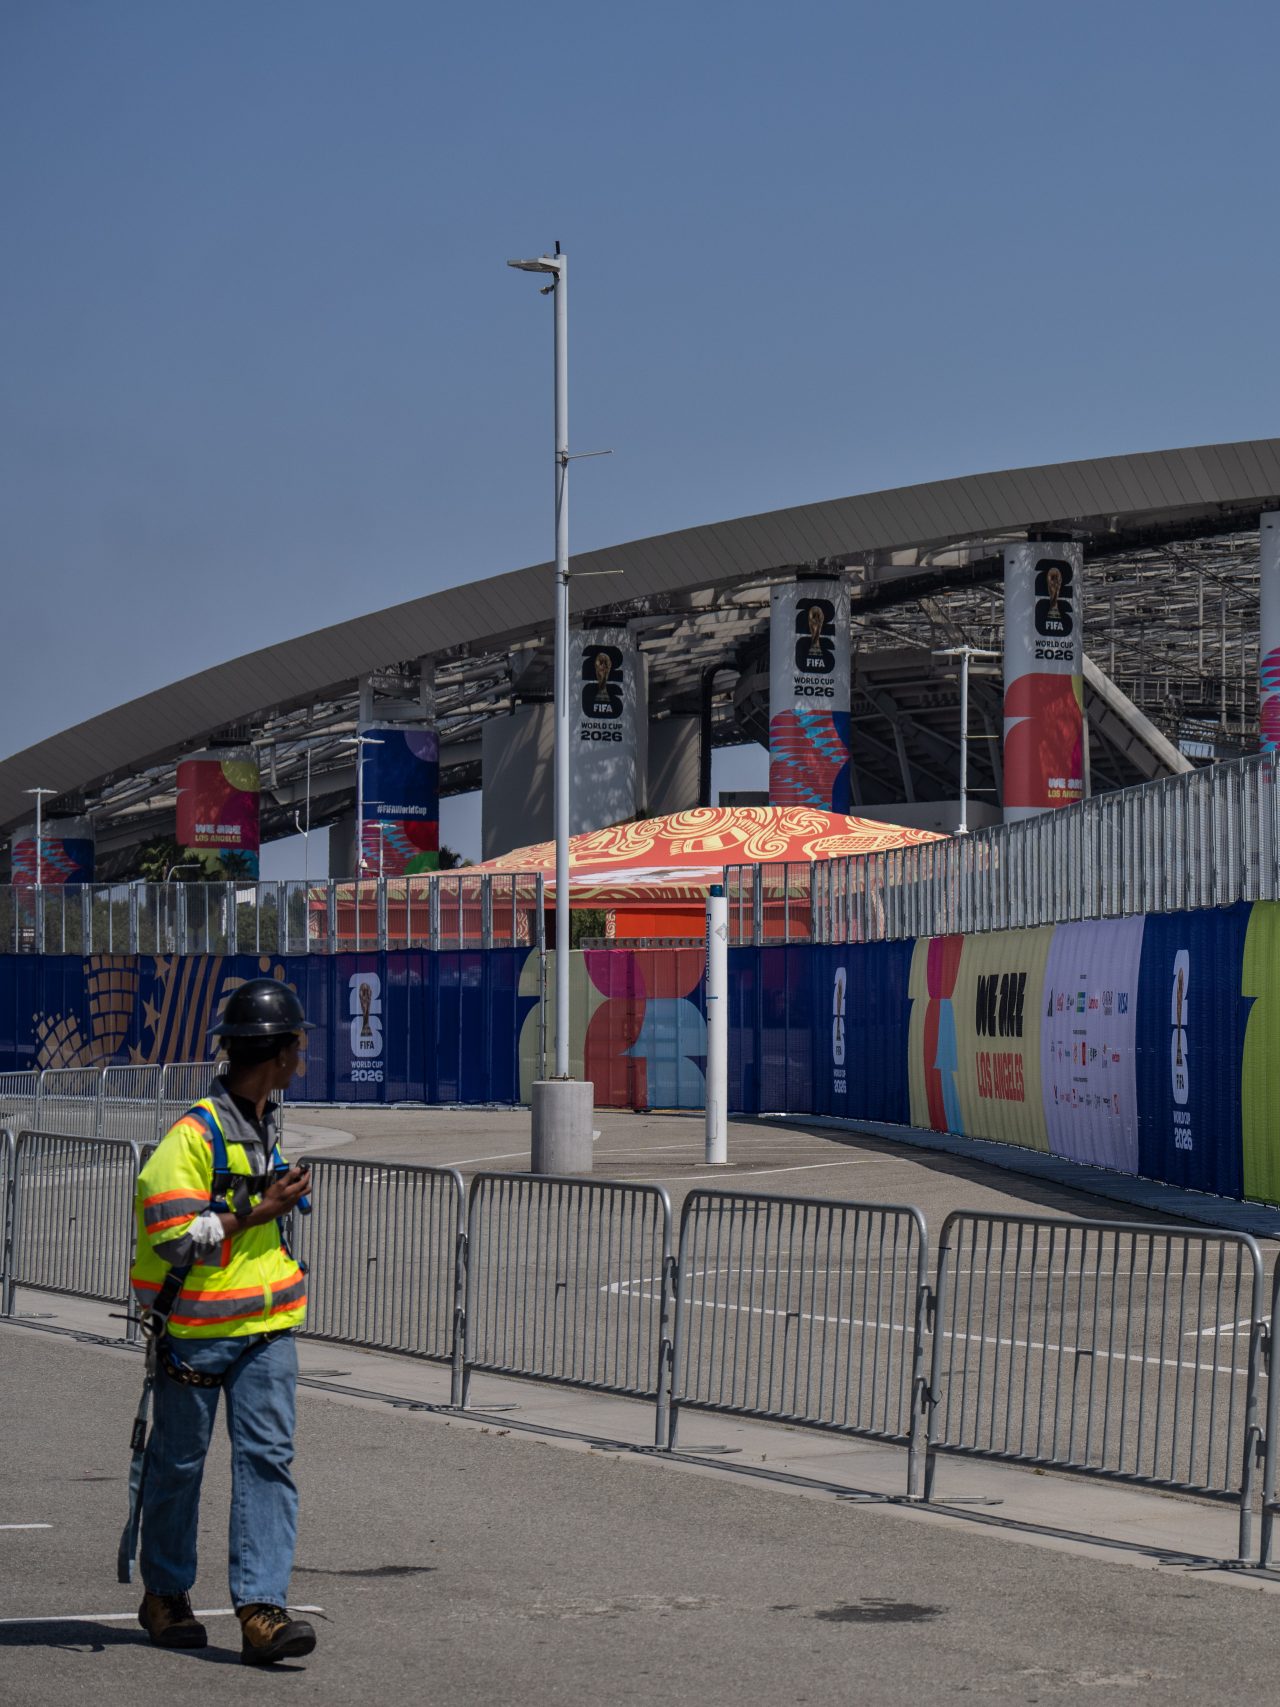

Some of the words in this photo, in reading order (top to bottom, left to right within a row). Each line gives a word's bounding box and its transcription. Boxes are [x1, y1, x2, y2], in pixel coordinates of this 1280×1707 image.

[1045, 620, 1063, 630] FIFA
[1035, 639, 1059, 648] WORLD
[1035, 649, 1073, 660] 2026
[806, 658, 825, 667] FIFA
[794, 676, 819, 684] WORLD
[794, 685, 834, 697] 2026
[593, 703, 613, 712] FIFA
[581, 721, 606, 729] WORLD
[580, 730, 622, 742] 2026
[377, 804, 427, 816] #FIFAWorldCup
[195, 834, 208, 842] LOS
[210, 834, 241, 843] ANGELES
[976, 974, 999, 1037] WE
[999, 972, 1027, 1037] ARE
[360, 1041, 374, 1049] FIFA
[351, 1070, 383, 1082] 2026
[976, 1052, 992, 1099] LOS
[993, 1052, 1024, 1103] ANGELES
